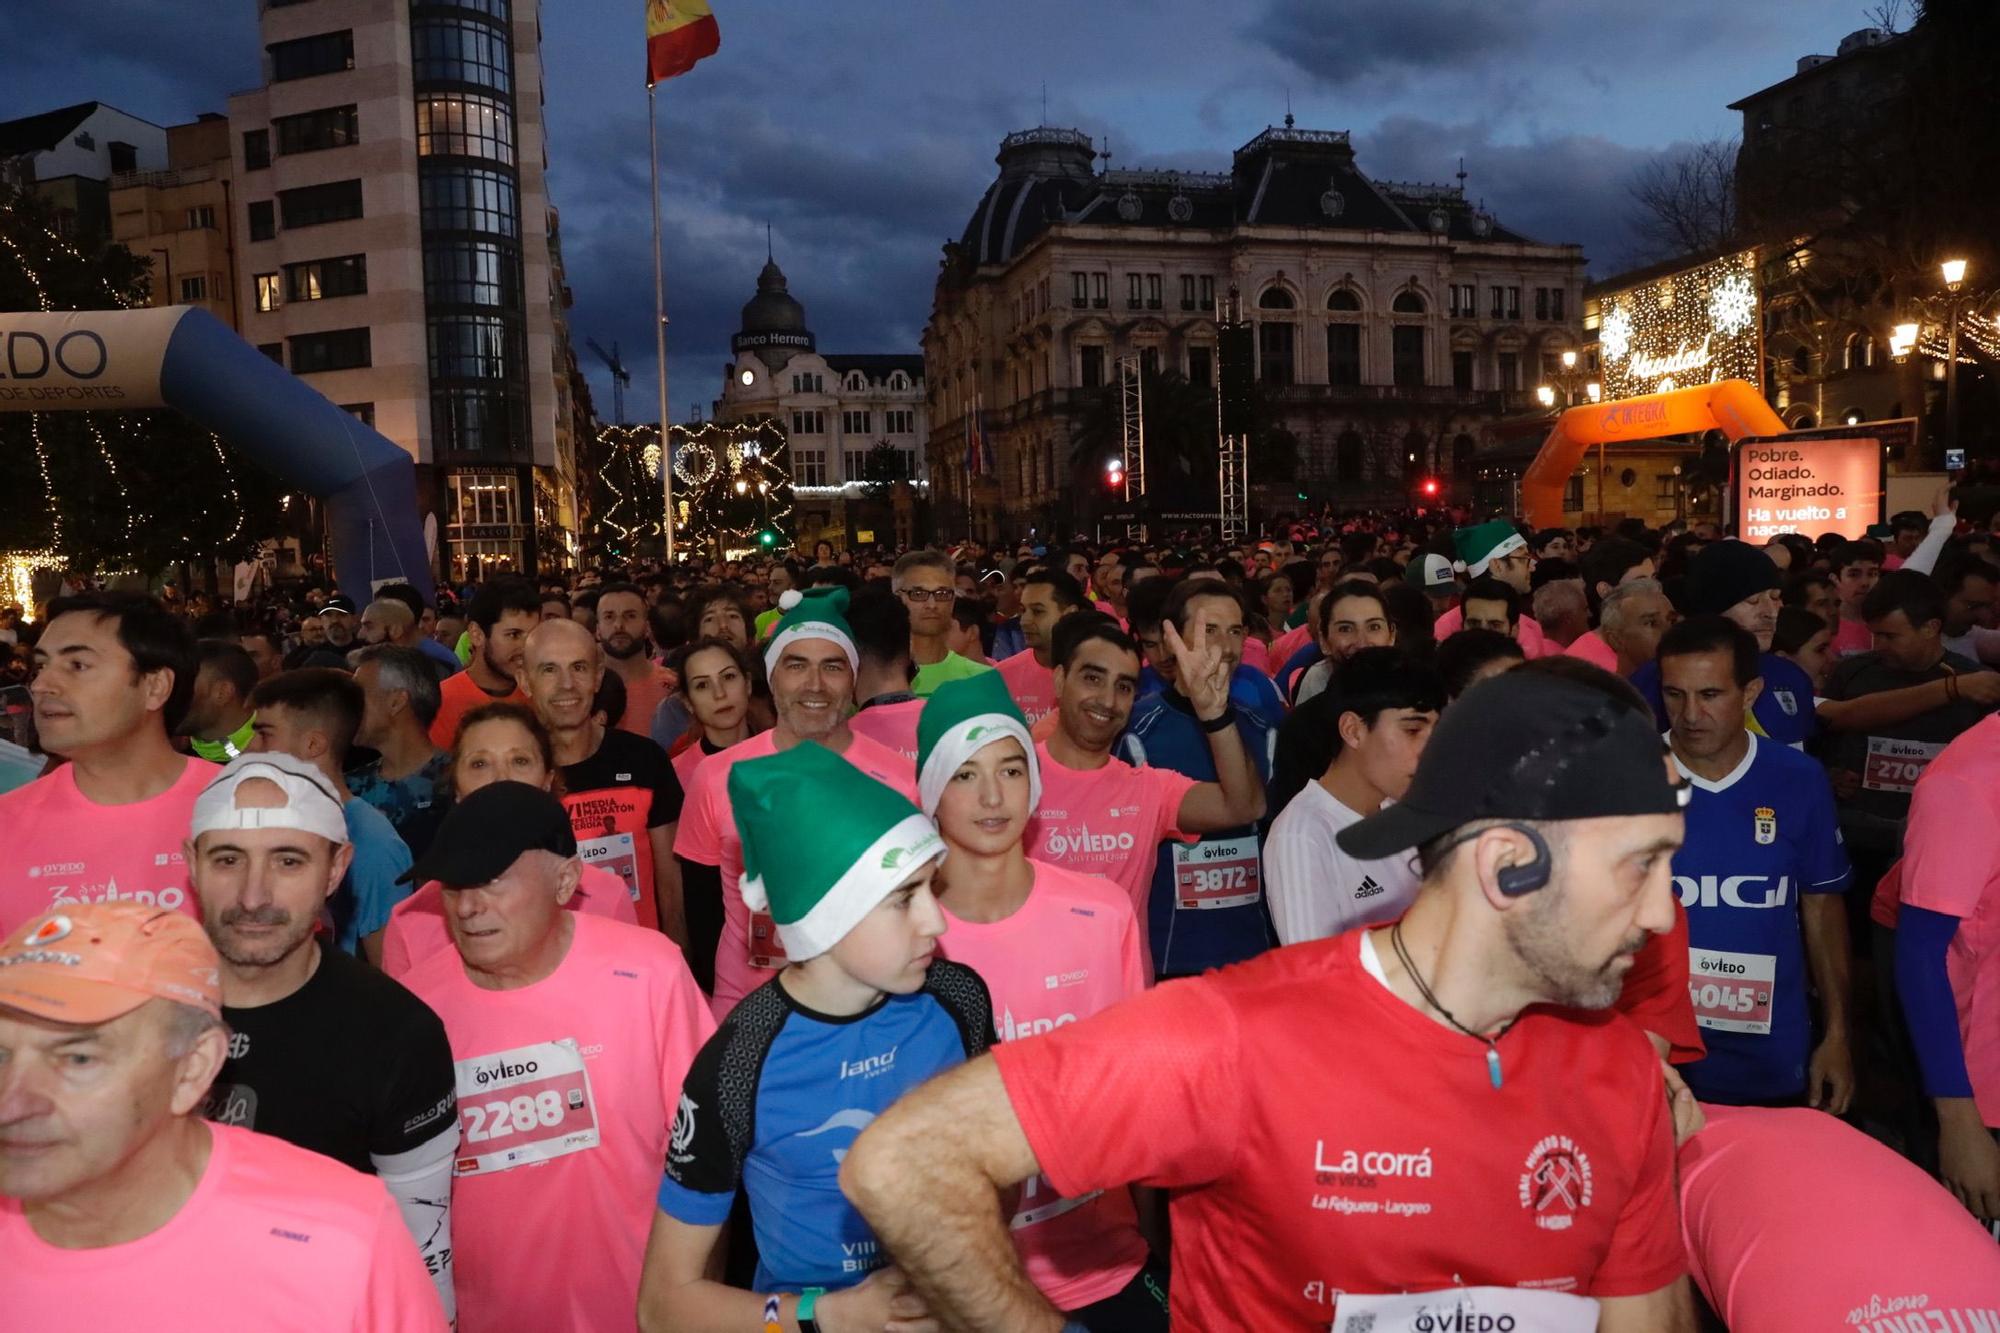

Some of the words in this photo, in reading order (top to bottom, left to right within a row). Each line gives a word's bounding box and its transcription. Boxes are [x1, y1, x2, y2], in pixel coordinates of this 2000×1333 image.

[737, 335, 766, 346] Banco
[770, 333, 809, 346] Herrero
[0, 330, 107, 380] DO
[28, 386, 126, 400] DEPORTES
[1622, 402, 1666, 424] INTEGRA
[1748, 448, 1804, 463] Pobre.
[1748, 466, 1816, 481] Odiado.
[1748, 483, 1845, 501] Marginado.
[1747, 507, 1771, 522] Ha
[1775, 505, 1831, 521] vuelto
[1835, 506, 1847, 520] a
[582, 798, 617, 809] MEDIA
[583, 803, 635, 818] MARATÓN
[1048, 828, 1134, 857] OVIEDO
[1203, 845, 1238, 859] OVIEDO
[1193, 866, 1247, 892] 3872
[1354, 886, 1385, 899] adidas
[1701, 957, 1746, 975] OVIEDO
[476, 1060, 539, 1084] OVIEDO
[463, 1090, 565, 1145] 2288
[1315, 1139, 1359, 1174] La
[1362, 1147, 1433, 1178] corrá
[1311, 1193, 1328, 1210] La
[1328, 1195, 1379, 1216] Felguera
[1385, 1199, 1432, 1217] Langreo
[1415, 1303, 1515, 1333] OVIEDO
